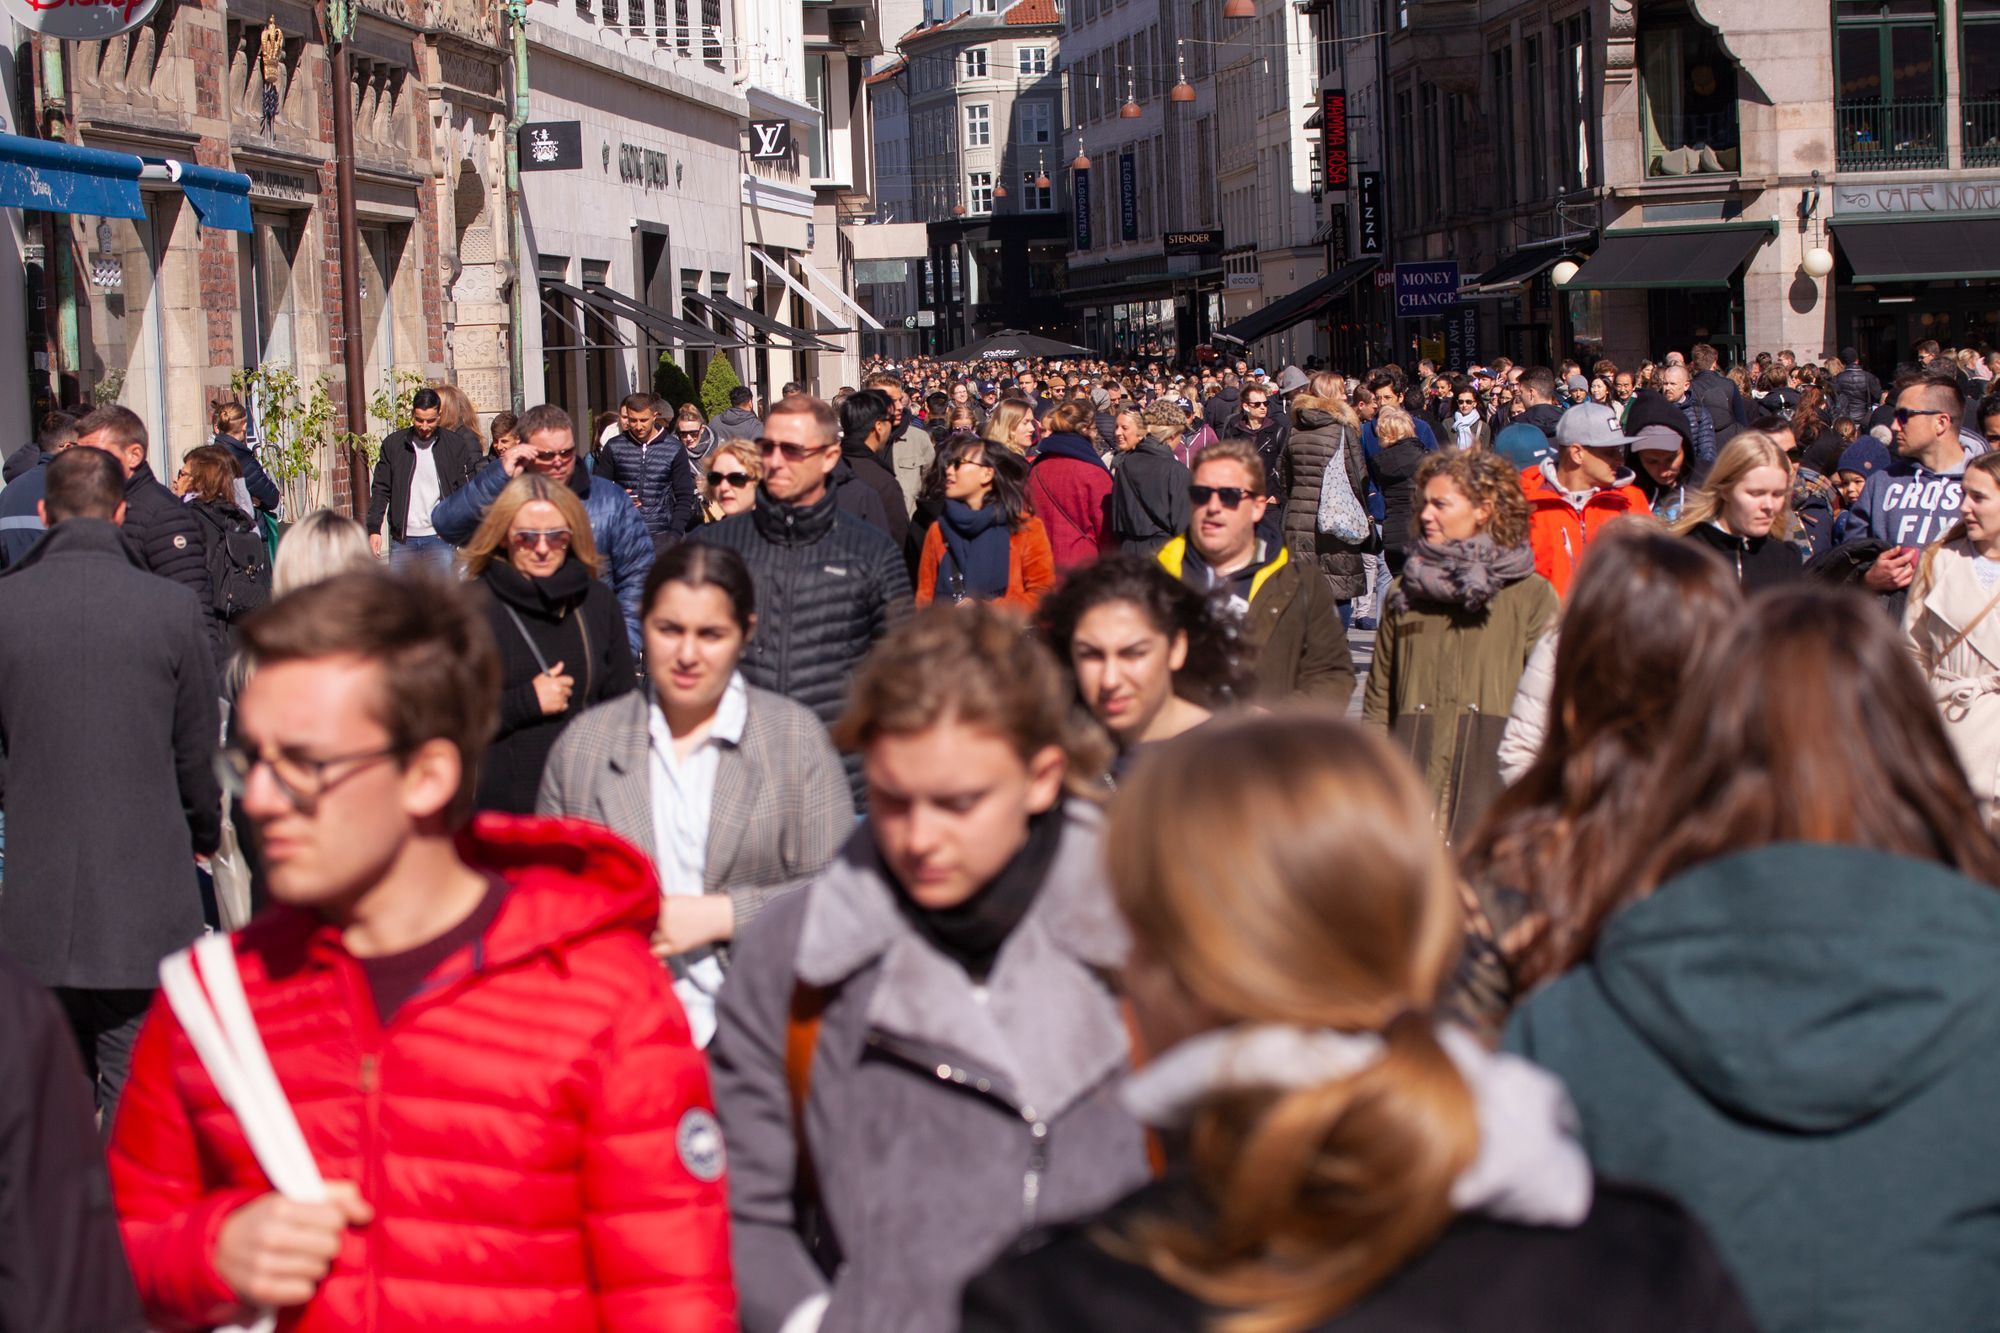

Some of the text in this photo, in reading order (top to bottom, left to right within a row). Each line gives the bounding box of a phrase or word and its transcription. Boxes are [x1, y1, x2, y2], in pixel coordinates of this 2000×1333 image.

[1327, 96, 1347, 183] MAMMA ROSA
[1078, 176, 1087, 237] ELGIGANTEN
[1123, 161, 1133, 227] ELGIGANTEN
[1364, 177, 1376, 249] PIZZA
[1168, 233, 1210, 244] STENDER
[1232, 277, 1256, 285] ecco
[1402, 271, 1451, 286] MONEY
[1400, 292, 1456, 306] CHANGE
[1449, 320, 1460, 343] HAY
[1464, 309, 1475, 356] DESIGN
